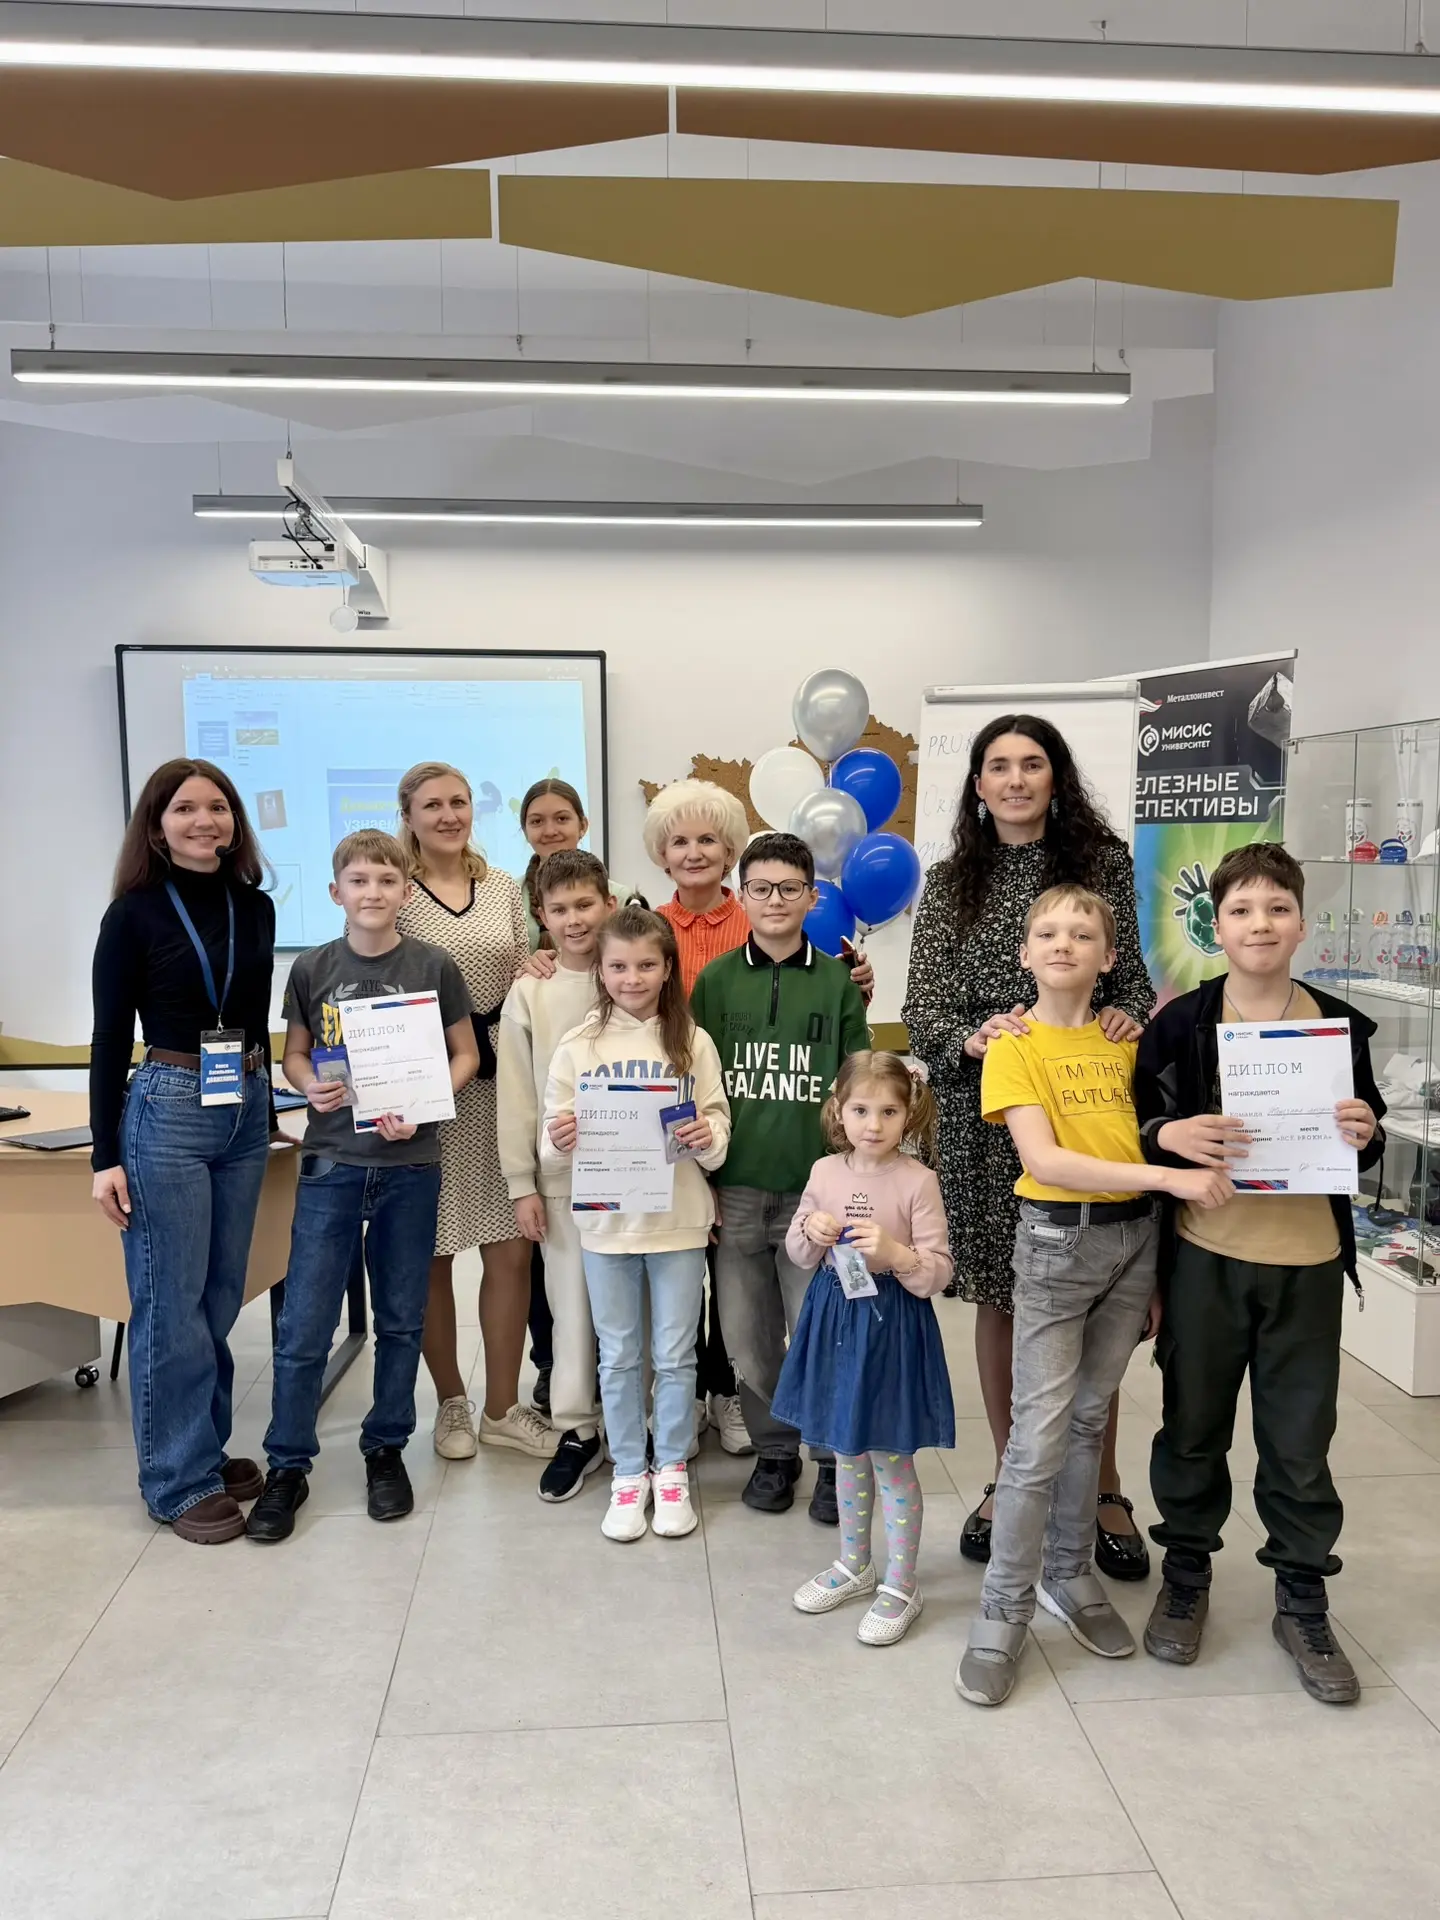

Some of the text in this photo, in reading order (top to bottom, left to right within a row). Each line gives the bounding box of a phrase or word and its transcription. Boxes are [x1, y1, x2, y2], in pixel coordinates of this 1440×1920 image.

[1167, 689, 1225, 704] Металлоинвест
[1161, 722, 1213, 741] МИСИС
[1161, 740, 1211, 752] УНИВЕРСИТЕТ
[361, 979, 381, 992] NYC
[348, 1023, 406, 1039] ДИПЛОМ
[733, 1042, 812, 1073] LIVE IN
[1054, 1061, 1126, 1081] I'M THE
[1227, 1062, 1303, 1077] ДИПЛОМ
[1061, 1087, 1133, 1108] FUTURE
[1228, 1089, 1280, 1097] награждается
[579, 1109, 639, 1121] ДИПЛОМ
